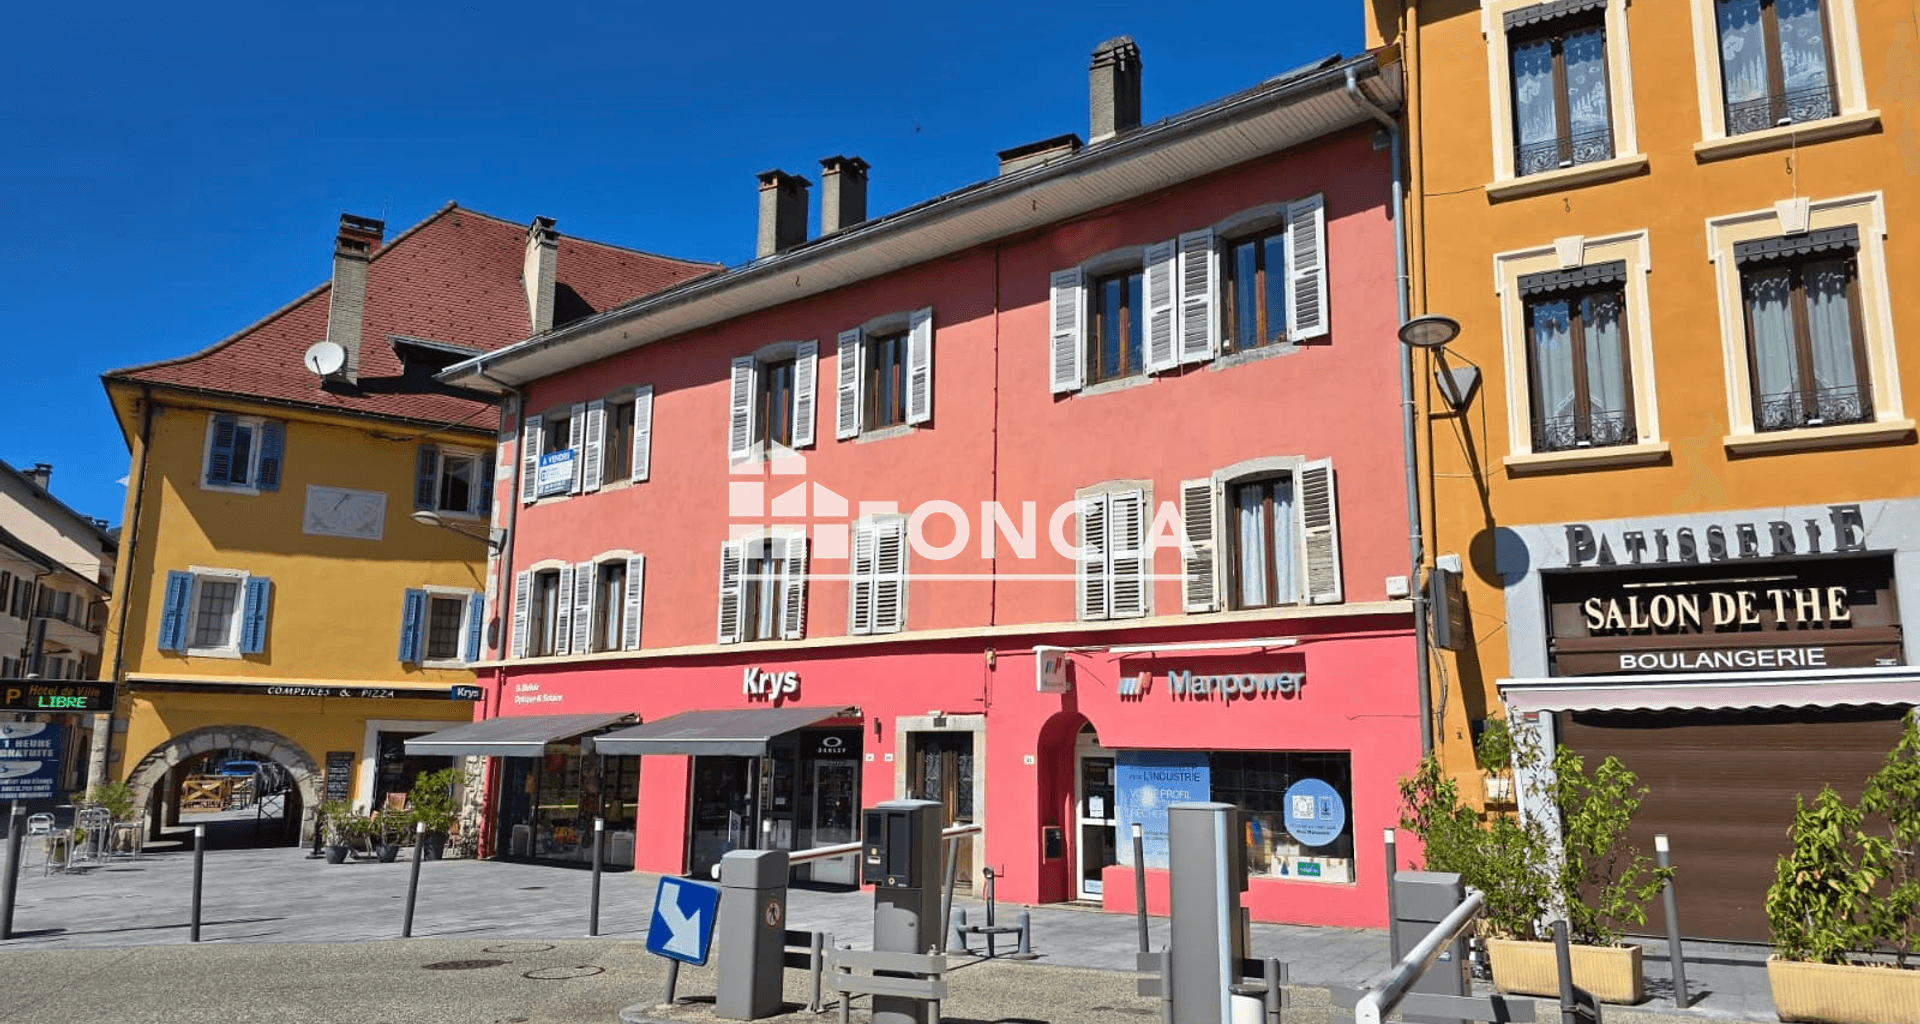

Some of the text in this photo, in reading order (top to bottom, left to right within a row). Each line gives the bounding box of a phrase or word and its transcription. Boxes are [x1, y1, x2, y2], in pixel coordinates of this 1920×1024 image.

[1564, 504, 1867, 565] PATISSERIE
[1584, 586, 1851, 630] SALON DE THE
[1619, 648, 1827, 669] BOULANGERIE
[267, 686, 394, 698] COMPLICES & PIZZA
[457, 687, 479, 698] Krys
[743, 667, 798, 700] Krys
[1167, 670, 1306, 701] Manpower
[6, 688, 21, 705] P
[38, 696, 87, 708] LIBRE
[1160, 789, 1190, 799] PROFIL
